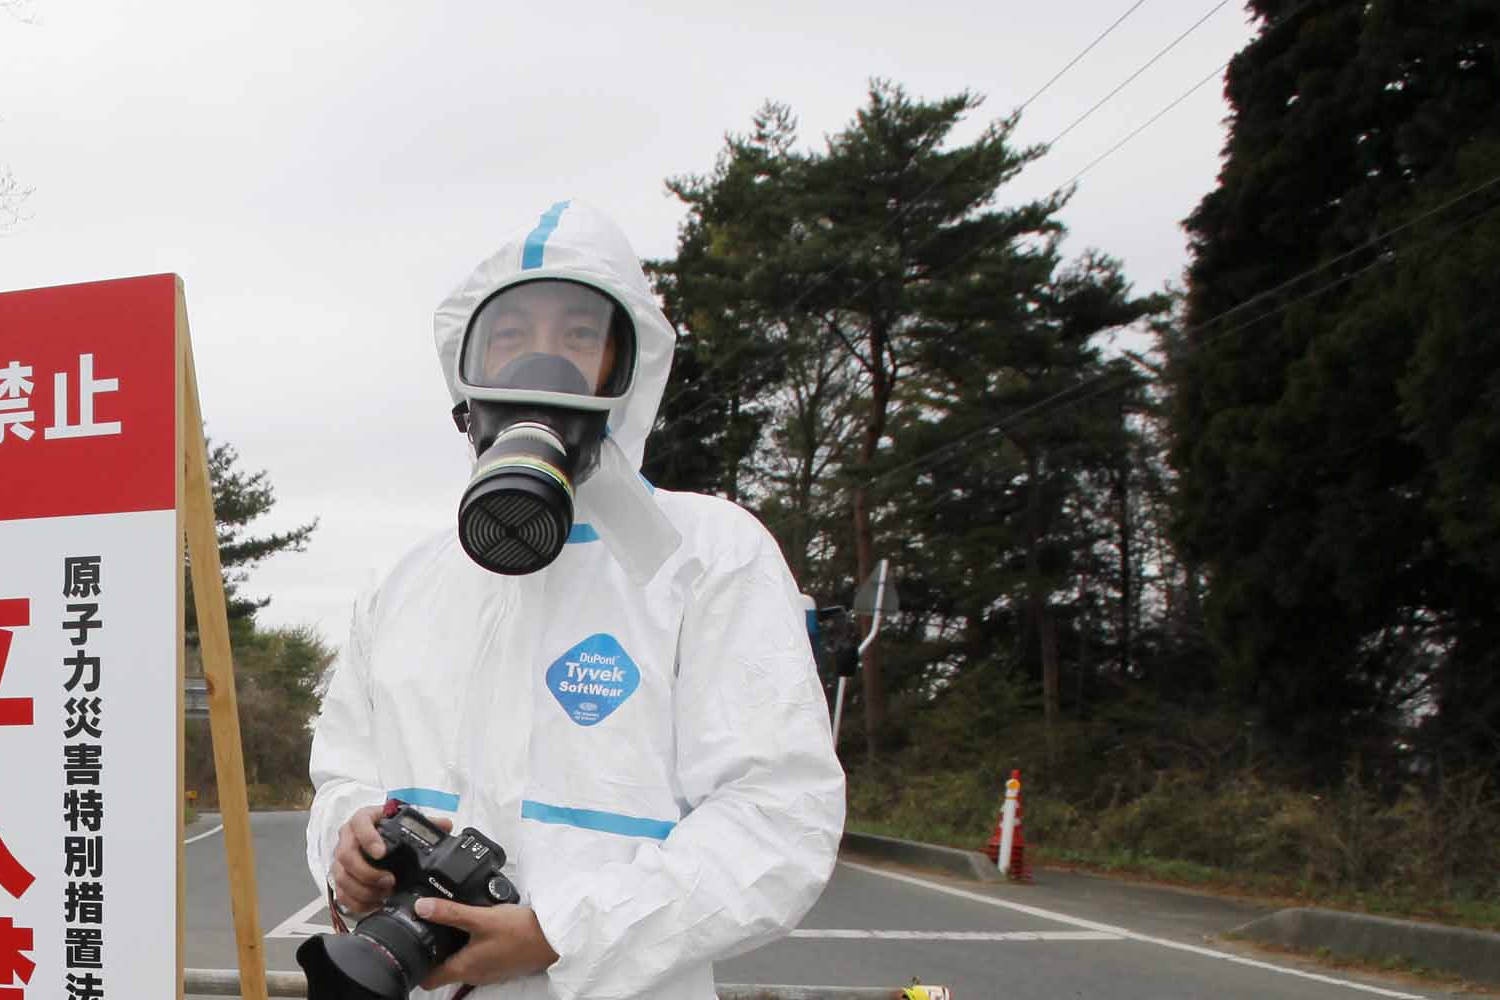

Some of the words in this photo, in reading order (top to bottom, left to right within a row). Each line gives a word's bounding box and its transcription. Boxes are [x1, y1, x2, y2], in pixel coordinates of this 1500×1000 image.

[565, 662, 626, 683] Tyvek
[559, 680, 624, 697] SoftWear
[428, 876, 454, 899] Canon
